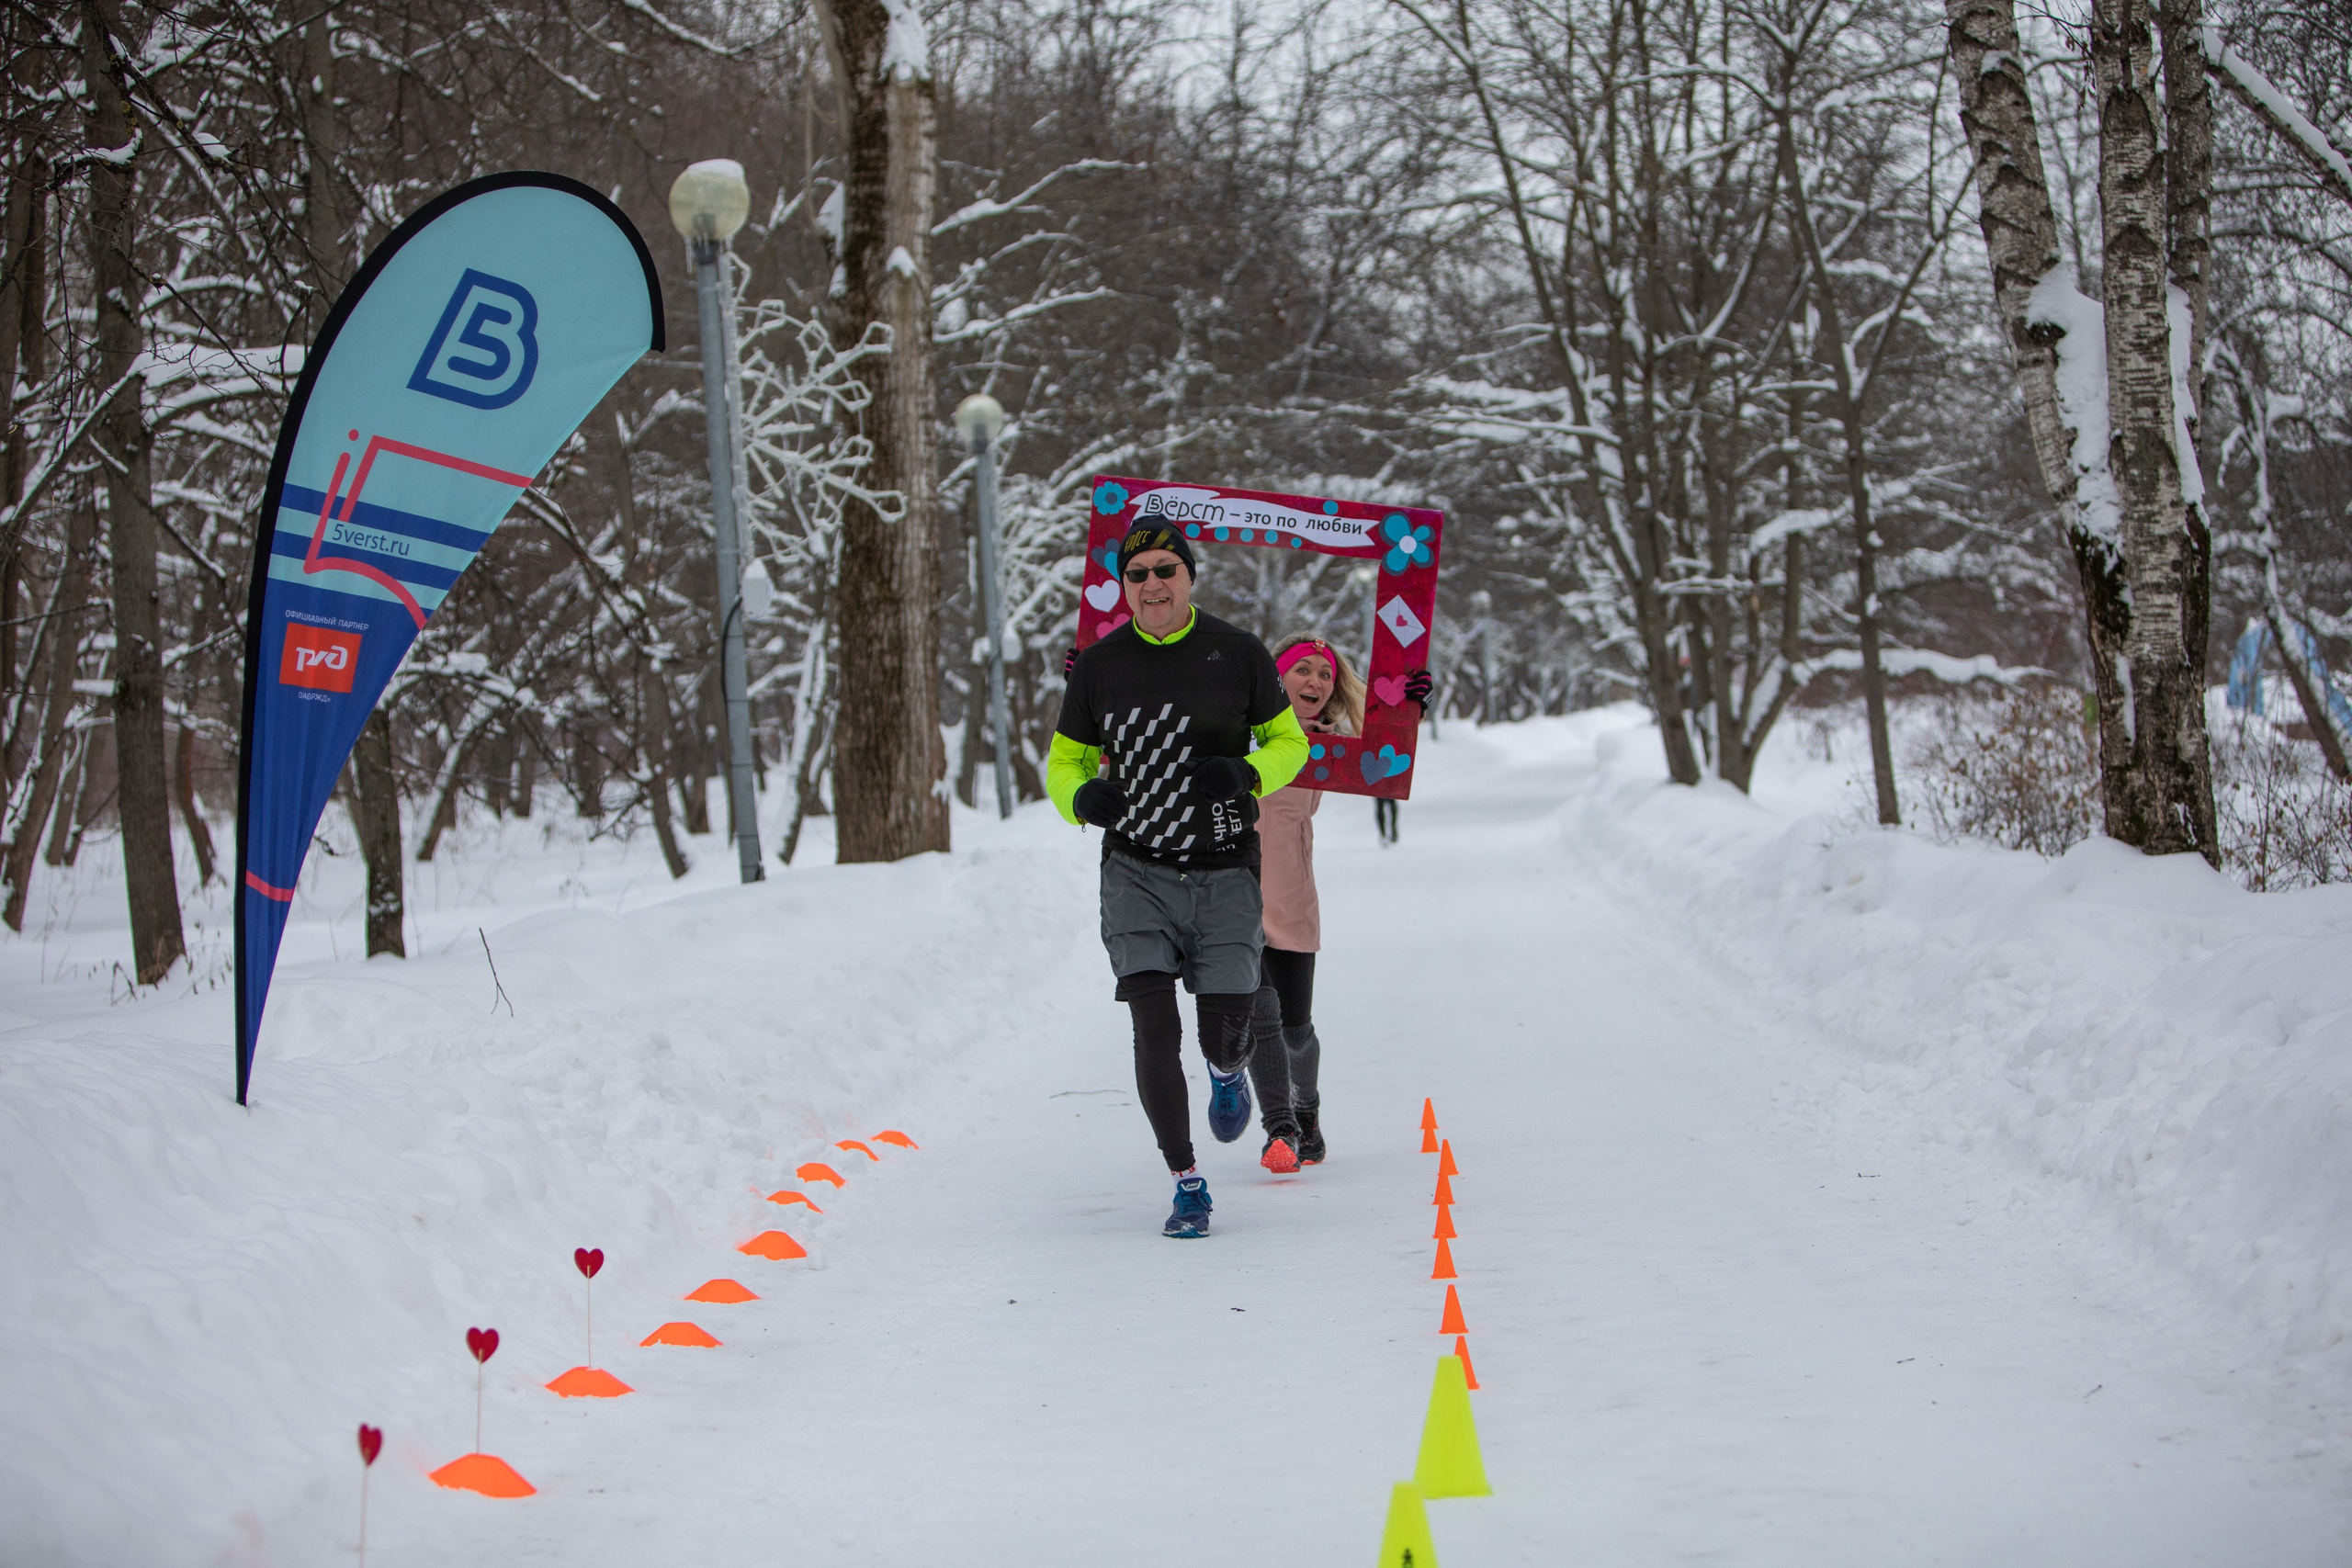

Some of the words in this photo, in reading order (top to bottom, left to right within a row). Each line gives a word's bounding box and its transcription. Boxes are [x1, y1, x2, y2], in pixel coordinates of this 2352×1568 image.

[1244, 512, 1272, 525] это
[1276, 516, 1297, 528] по
[1305, 516, 1363, 536] любви
[332, 523, 411, 557] 5verst.ru
[337, 619, 369, 631] ПАРТНЕР
